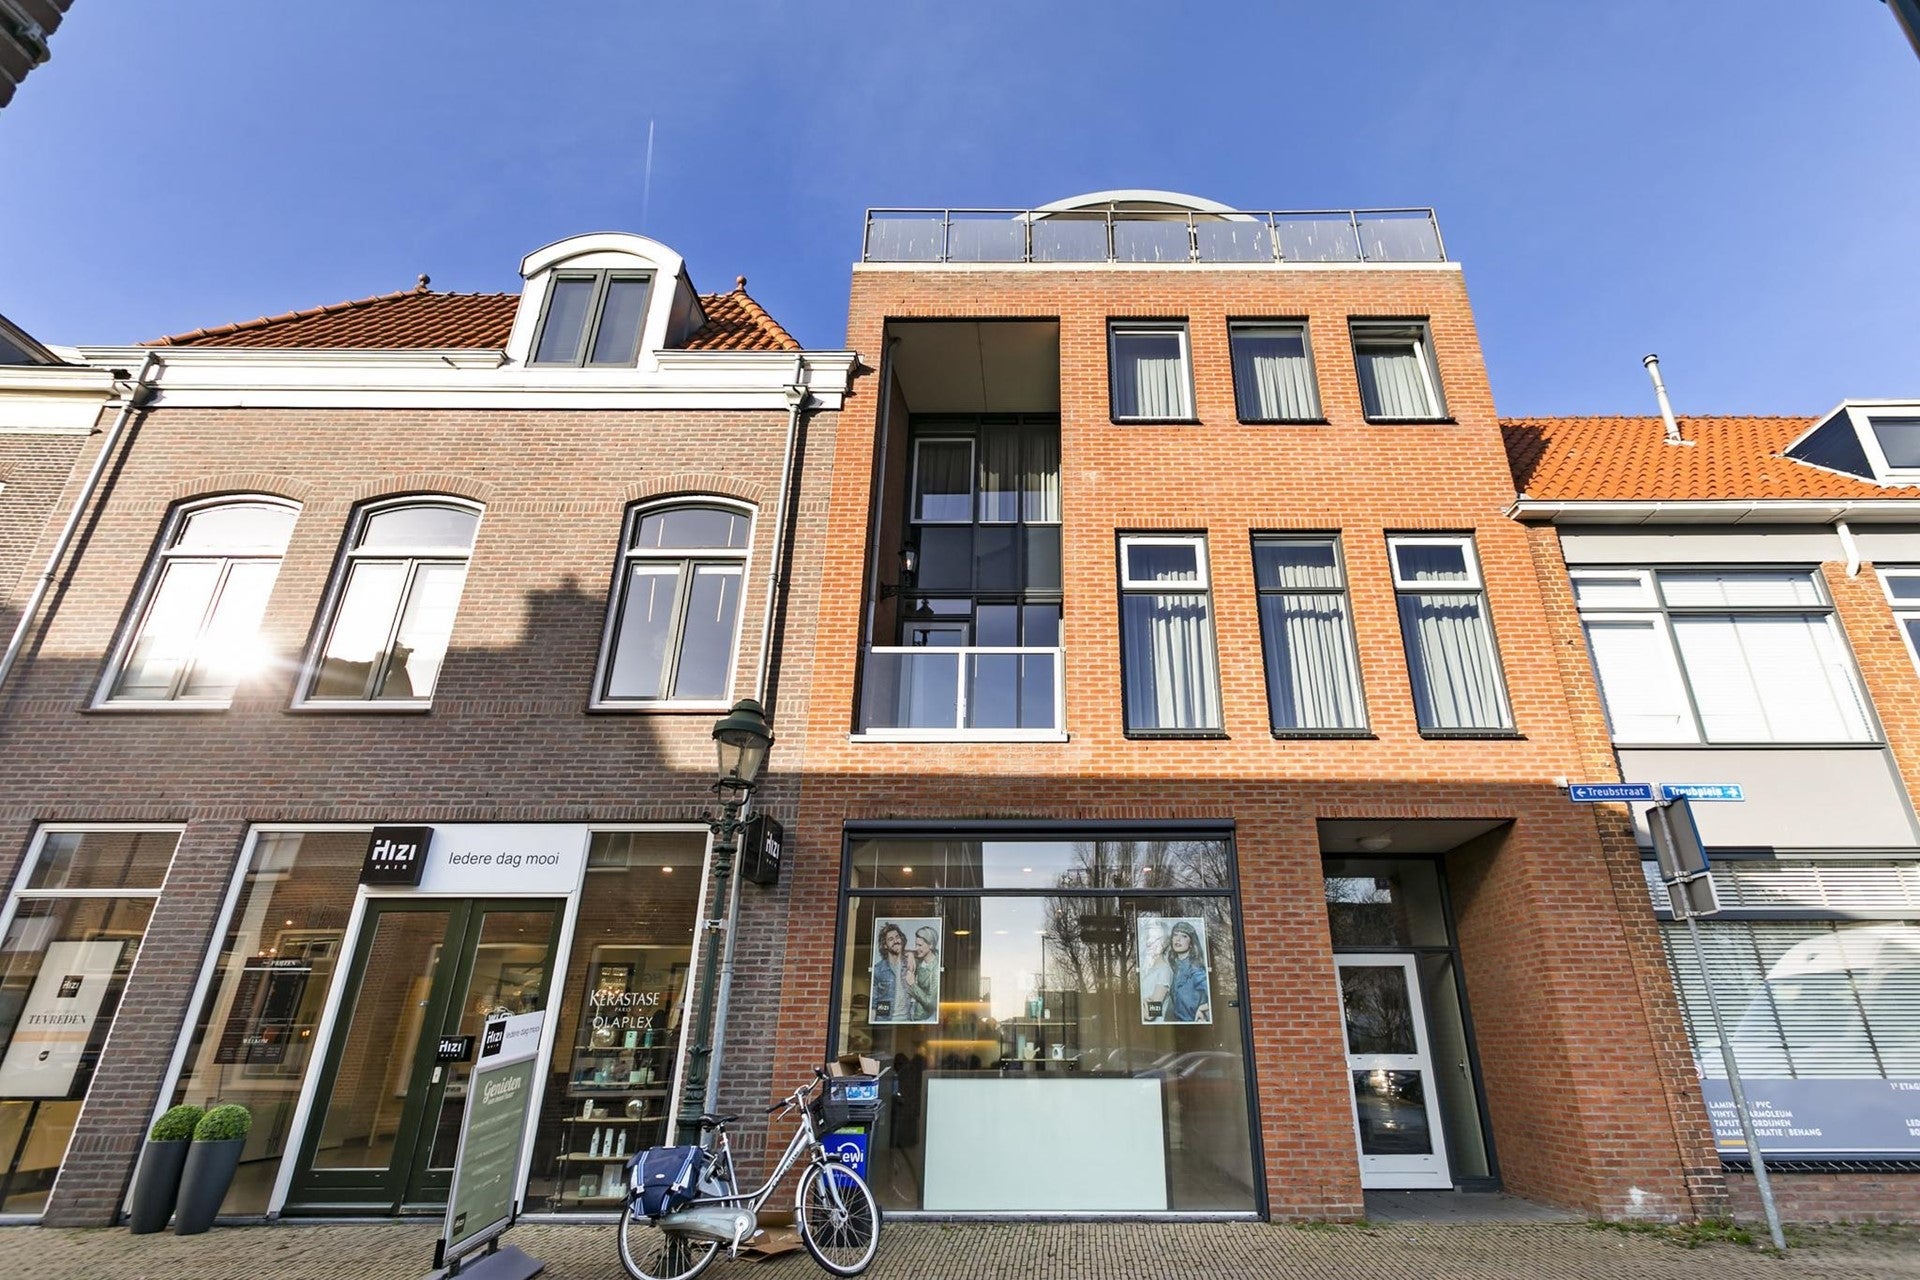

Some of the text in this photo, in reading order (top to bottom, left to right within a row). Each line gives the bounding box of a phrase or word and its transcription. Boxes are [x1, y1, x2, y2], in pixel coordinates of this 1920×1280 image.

[1587, 787, 1645, 796] Treubstraat
[371, 839, 417, 861] HIZI
[449, 852, 560, 868] Iedere dag mooi
[28, 1014, 86, 1025] TEVREDEN
[592, 1016, 653, 1029] OLAPLEX
[439, 1040, 462, 1053] HIZI
[482, 1076, 522, 1104] Genieten
